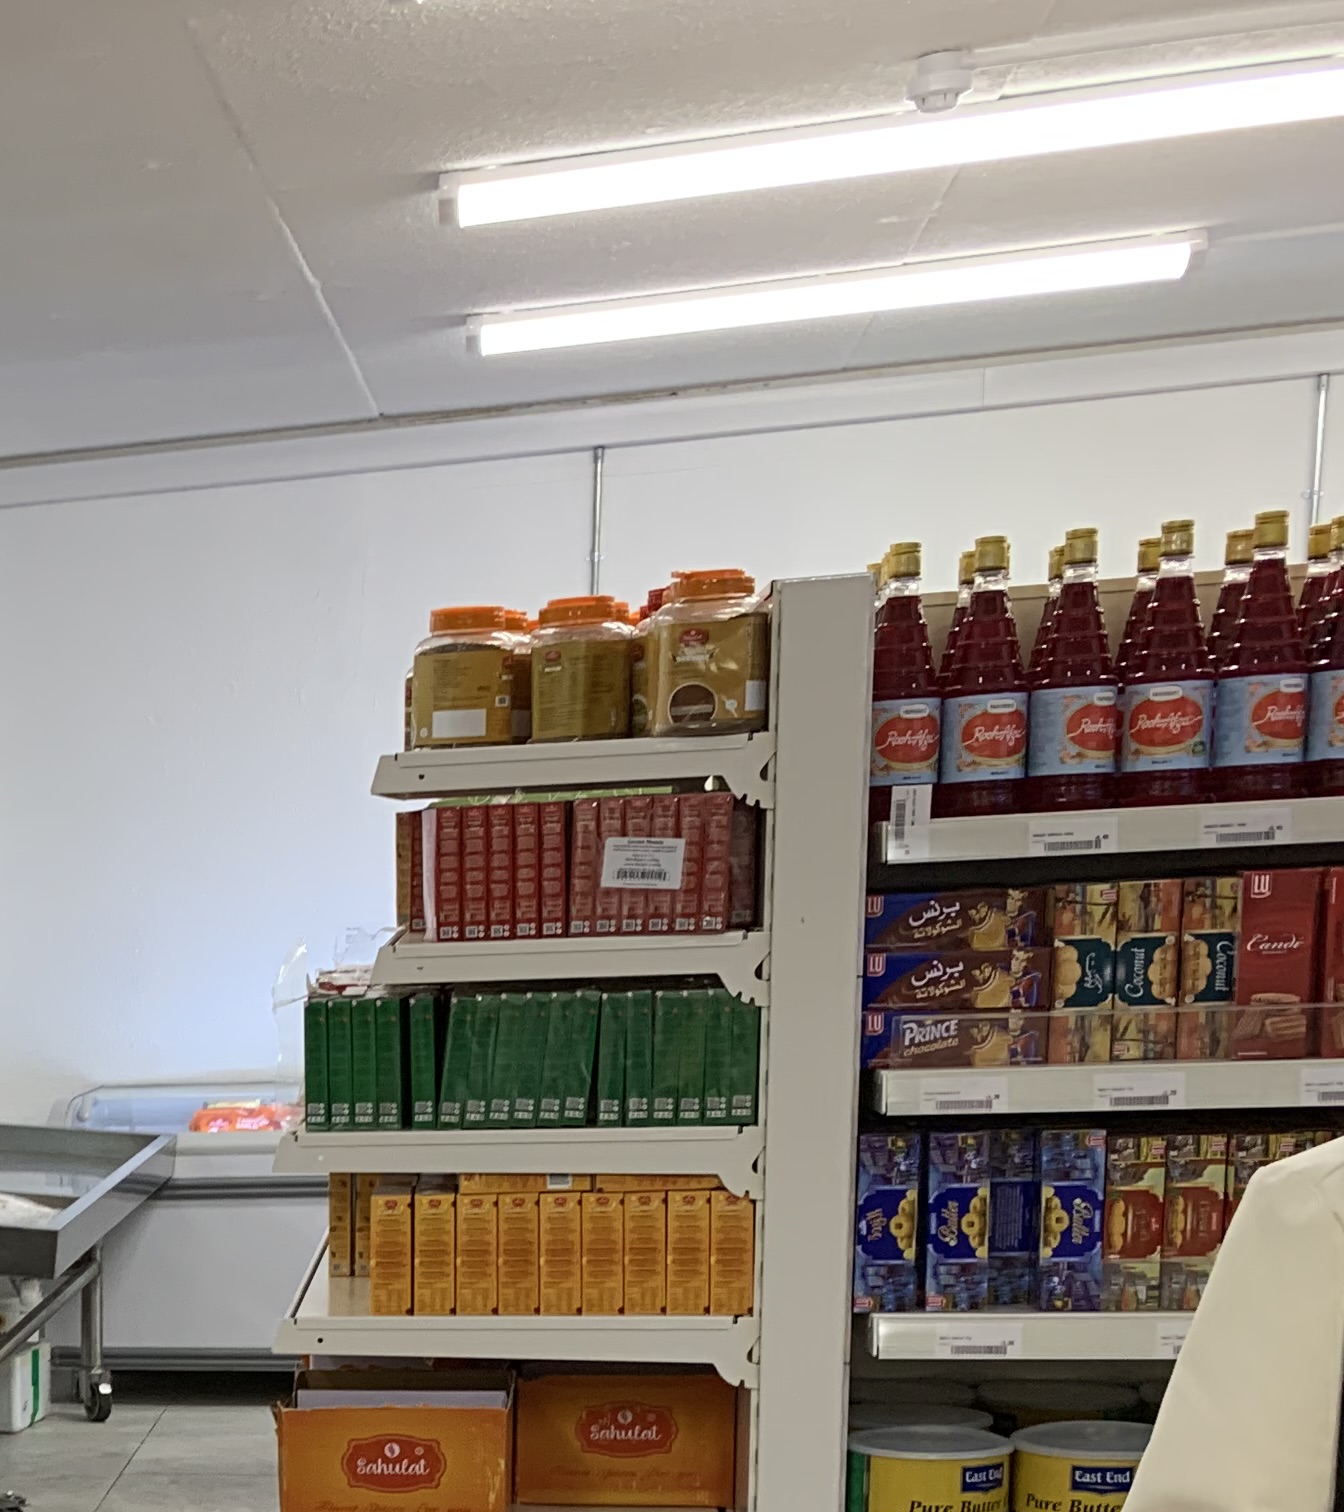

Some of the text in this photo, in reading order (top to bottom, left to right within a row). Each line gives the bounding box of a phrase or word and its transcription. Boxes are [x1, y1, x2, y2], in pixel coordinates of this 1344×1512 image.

[1252, 873, 1271, 896] LU
[867, 899, 882, 913] LU
[869, 956, 884, 969] LU
[1124, 947, 1147, 998] Coconut
[1213, 940, 1235, 993] Coconut
[868, 1014, 882, 1029] LU
[902, 1019, 959, 1046] PRINCE
[589, 1421, 663, 1442] Sahulat
[356, 1454, 432, 1476] Sahulat
[965, 1465, 1003, 1483] East End
[1073, 1469, 1130, 1484] East End
[1024, 1493, 1063, 1512] Pure
